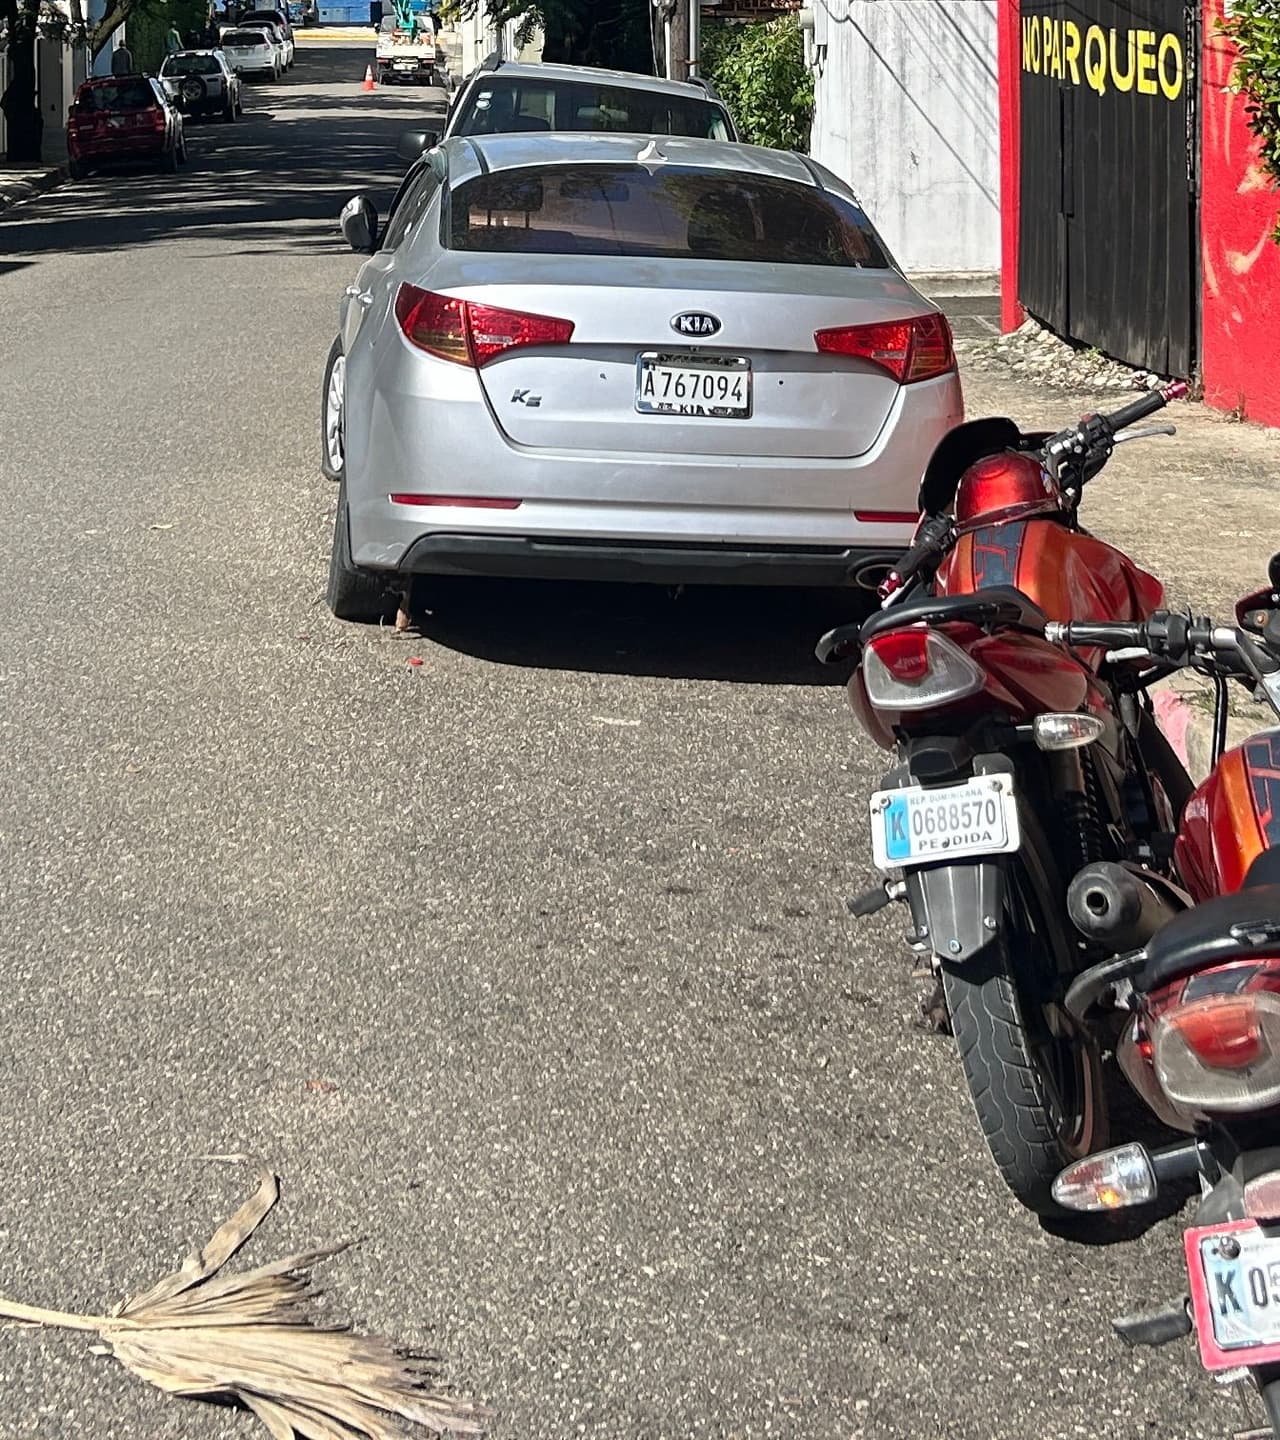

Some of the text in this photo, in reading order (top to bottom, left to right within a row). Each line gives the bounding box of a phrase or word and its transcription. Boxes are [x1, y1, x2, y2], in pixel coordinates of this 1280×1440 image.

[1022, 15, 1183, 101] NO PARQUEO
[680, 316, 714, 332] KIA
